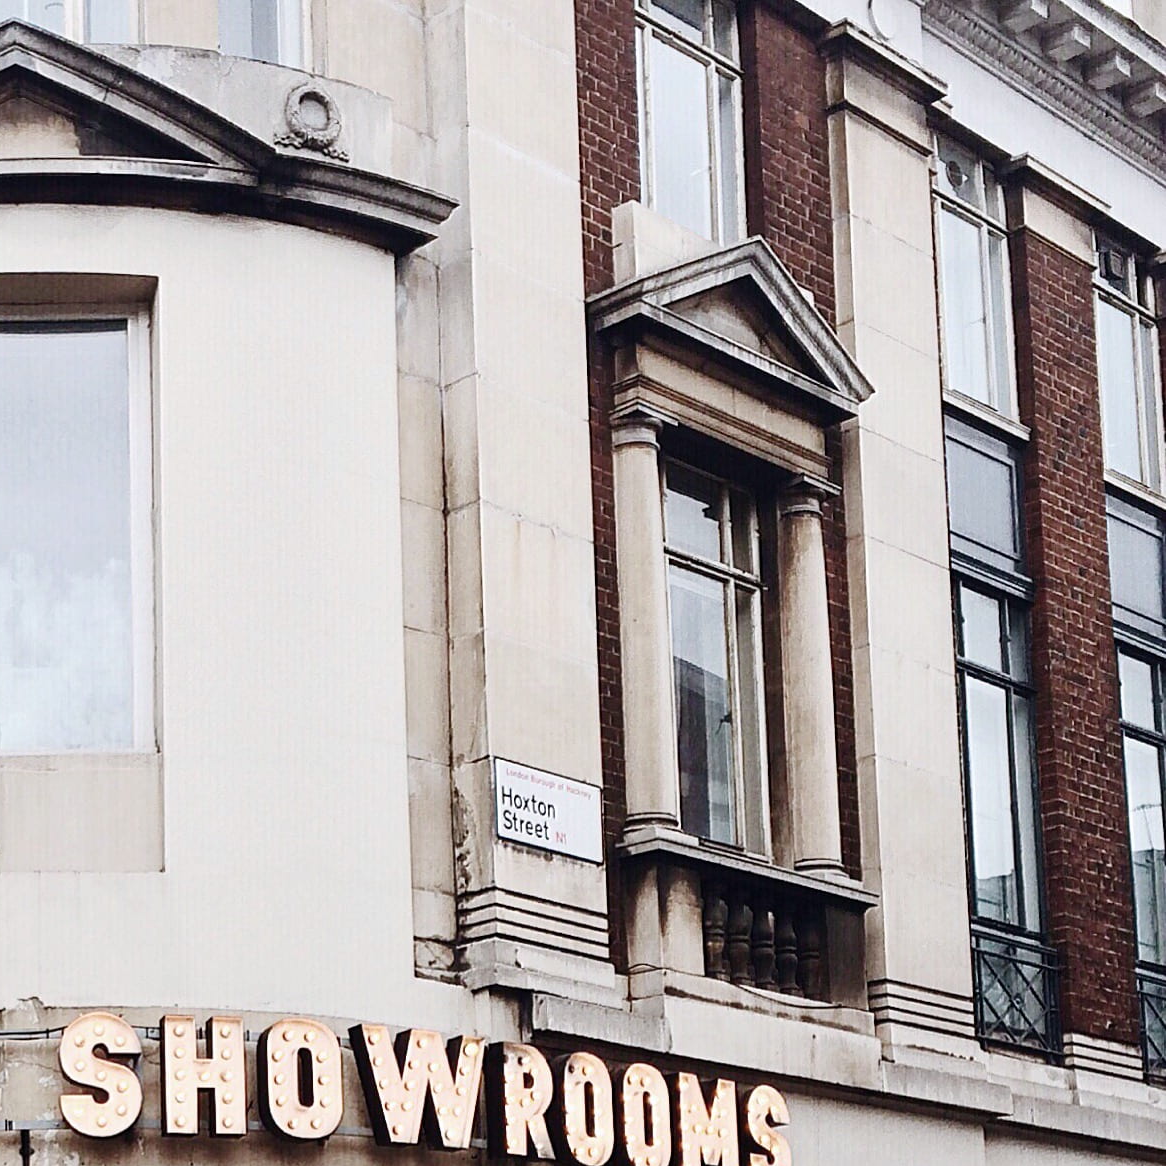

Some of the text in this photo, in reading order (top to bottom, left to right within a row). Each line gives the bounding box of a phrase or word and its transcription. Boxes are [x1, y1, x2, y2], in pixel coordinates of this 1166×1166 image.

[501, 785, 556, 820] Hoxton
[502, 809, 567, 845] Street N1
